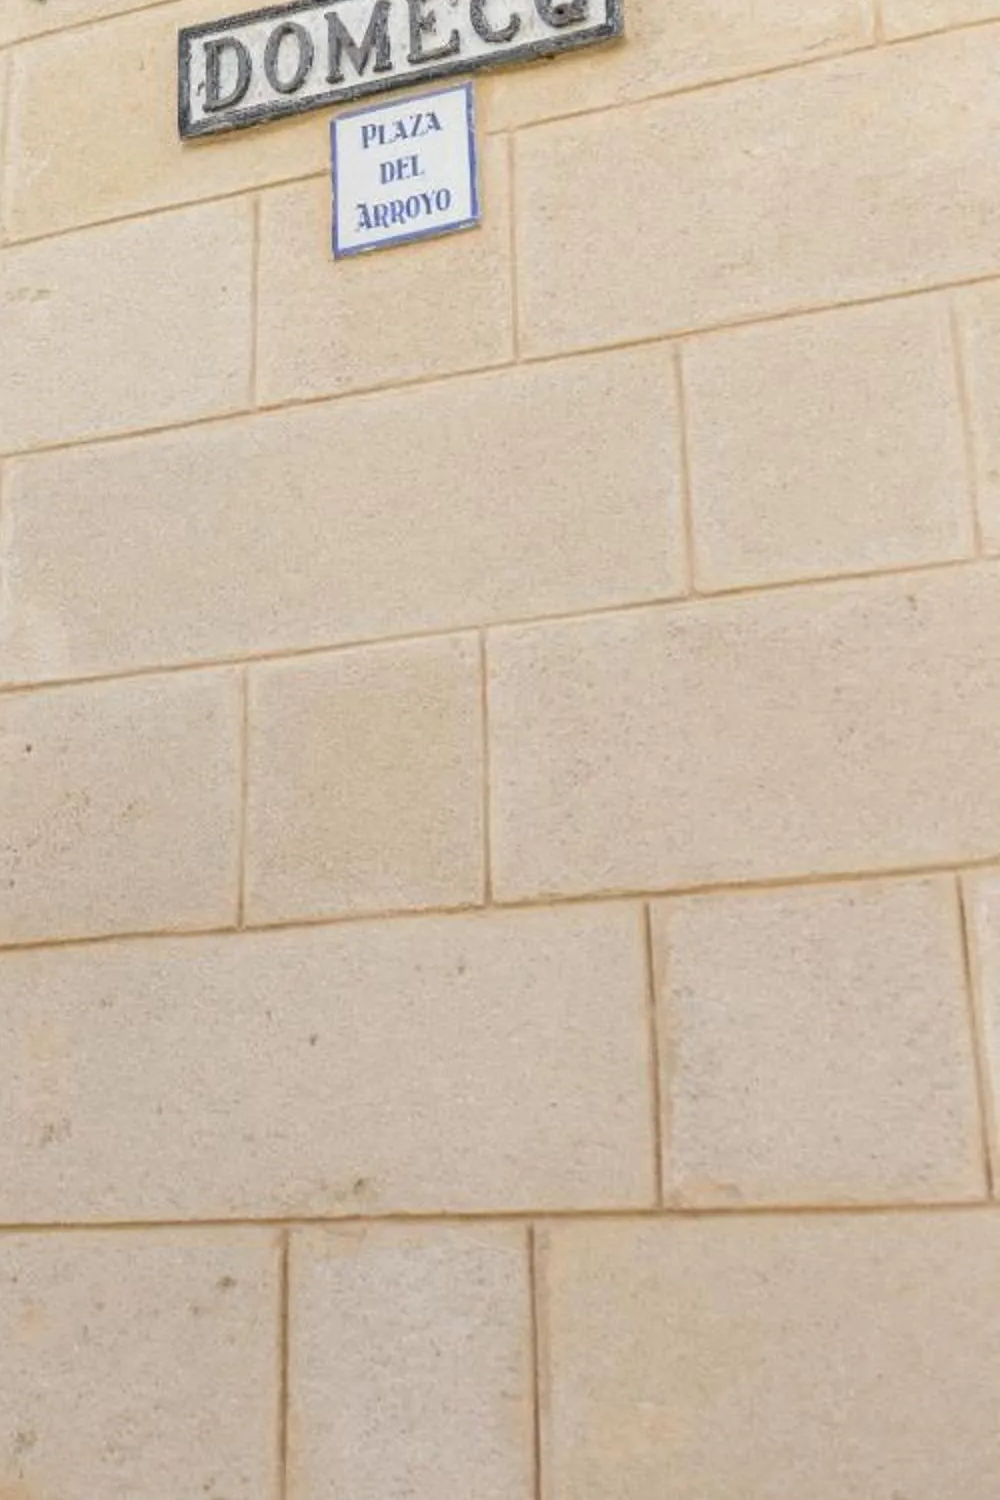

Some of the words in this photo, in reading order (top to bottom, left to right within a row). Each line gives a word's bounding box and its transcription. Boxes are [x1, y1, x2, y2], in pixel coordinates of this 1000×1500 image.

[360, 111, 442, 149] PLAZA
[379, 154, 425, 185] DEL
[355, 188, 452, 233] ARROYO
